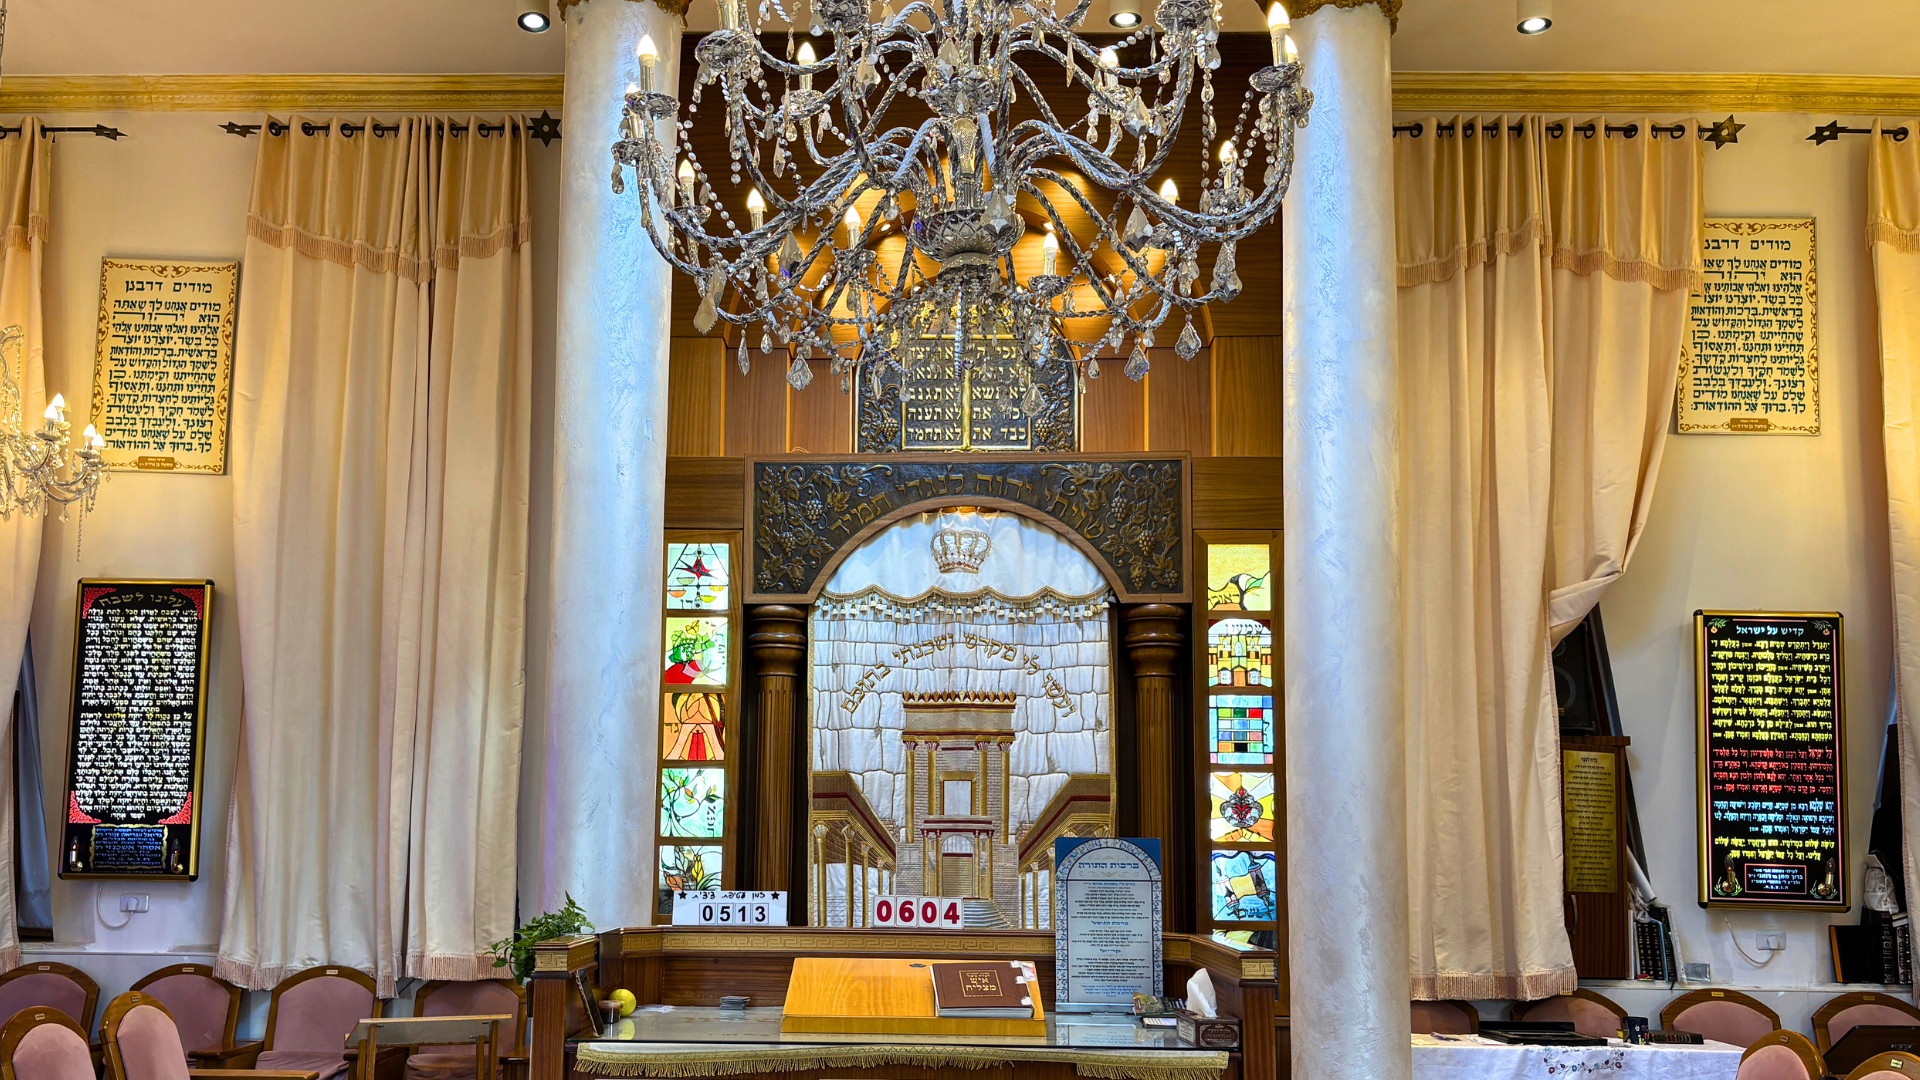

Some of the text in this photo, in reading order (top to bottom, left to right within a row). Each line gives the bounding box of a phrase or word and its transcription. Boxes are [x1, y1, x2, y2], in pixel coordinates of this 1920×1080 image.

[1703, 238, 1790, 250] מודים דרבנ
[125, 280, 212, 293] מודים דרבנן
[907, 402, 962, 420] לא תענה
[972, 407, 992, 420] את
[907, 422, 962, 441] לא תחמד
[972, 427, 1027, 440] כבד את
[828, 464, 1105, 539] שויתי יהוה לנגדי תמיד
[99, 592, 186, 607] עלינו לשבח
[1736, 625, 1804, 637] קדיש על ישראל
[841, 631, 1077, 718] ועשו לי מקדש ושכנתי בתוכם
[702, 905, 766, 922] 0513
[876, 900, 960, 925] 0604
